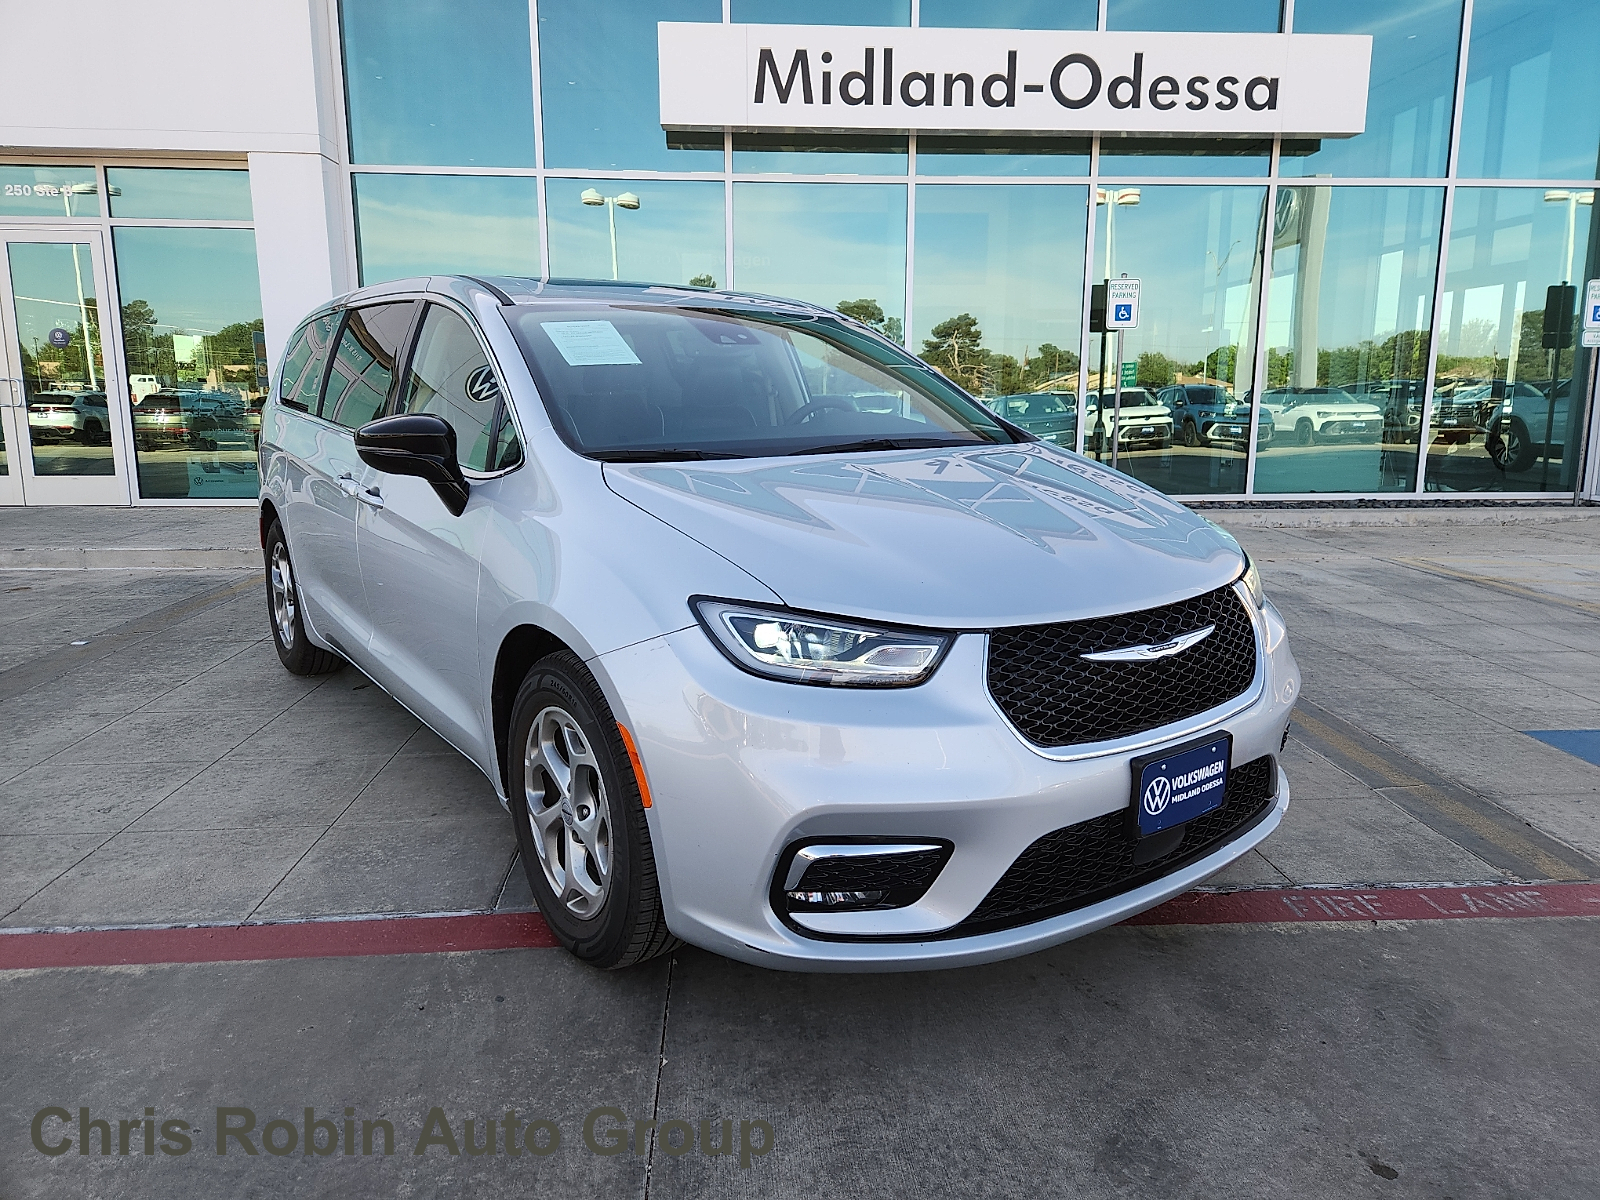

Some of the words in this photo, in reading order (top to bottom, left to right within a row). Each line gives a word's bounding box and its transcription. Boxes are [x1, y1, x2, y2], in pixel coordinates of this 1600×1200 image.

[754, 47, 1280, 110] Midland-Odessa
[5, 184, 31, 196] 250
[36, 184, 59, 197] Ste
[63, 184, 73, 197] B
[1171, 760, 1225, 791] VOLKSWAGEN
[1171, 786, 1201, 804] MIDLAND
[1201, 777, 1224, 793] ODESSA
[1281, 895, 1394, 917] FIRE
[1418, 890, 1561, 914] LANE
